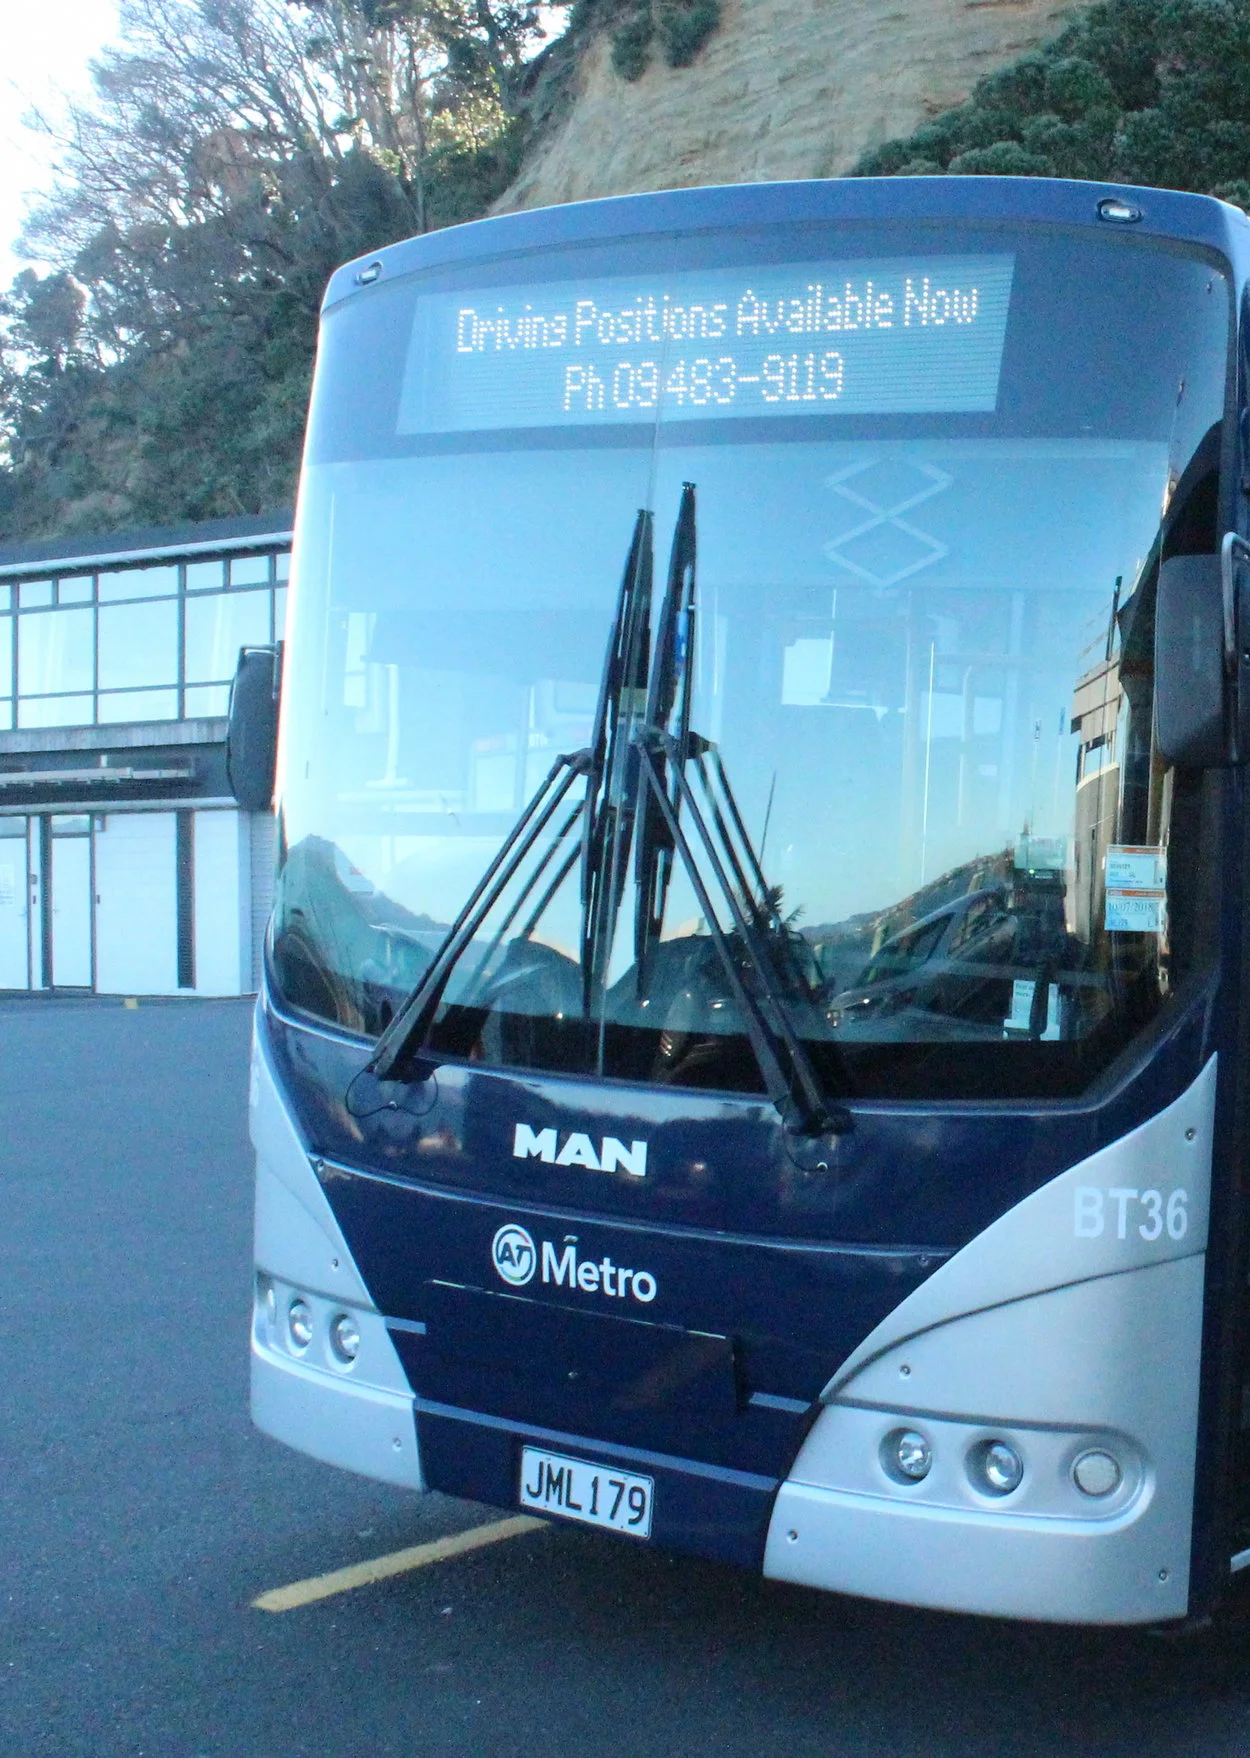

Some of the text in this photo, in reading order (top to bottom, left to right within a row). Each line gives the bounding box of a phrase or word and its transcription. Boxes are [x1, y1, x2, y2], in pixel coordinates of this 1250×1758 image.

[457, 277, 978, 352] Driving Positions Available Now
[564, 353, 844, 410] Ph 09 483-9119
[513, 1123, 648, 1176] MAN
[1074, 1185, 1188, 1241] BT36
[541, 1240, 657, 1303] Metro
[526, 1461, 647, 1525] JML179
